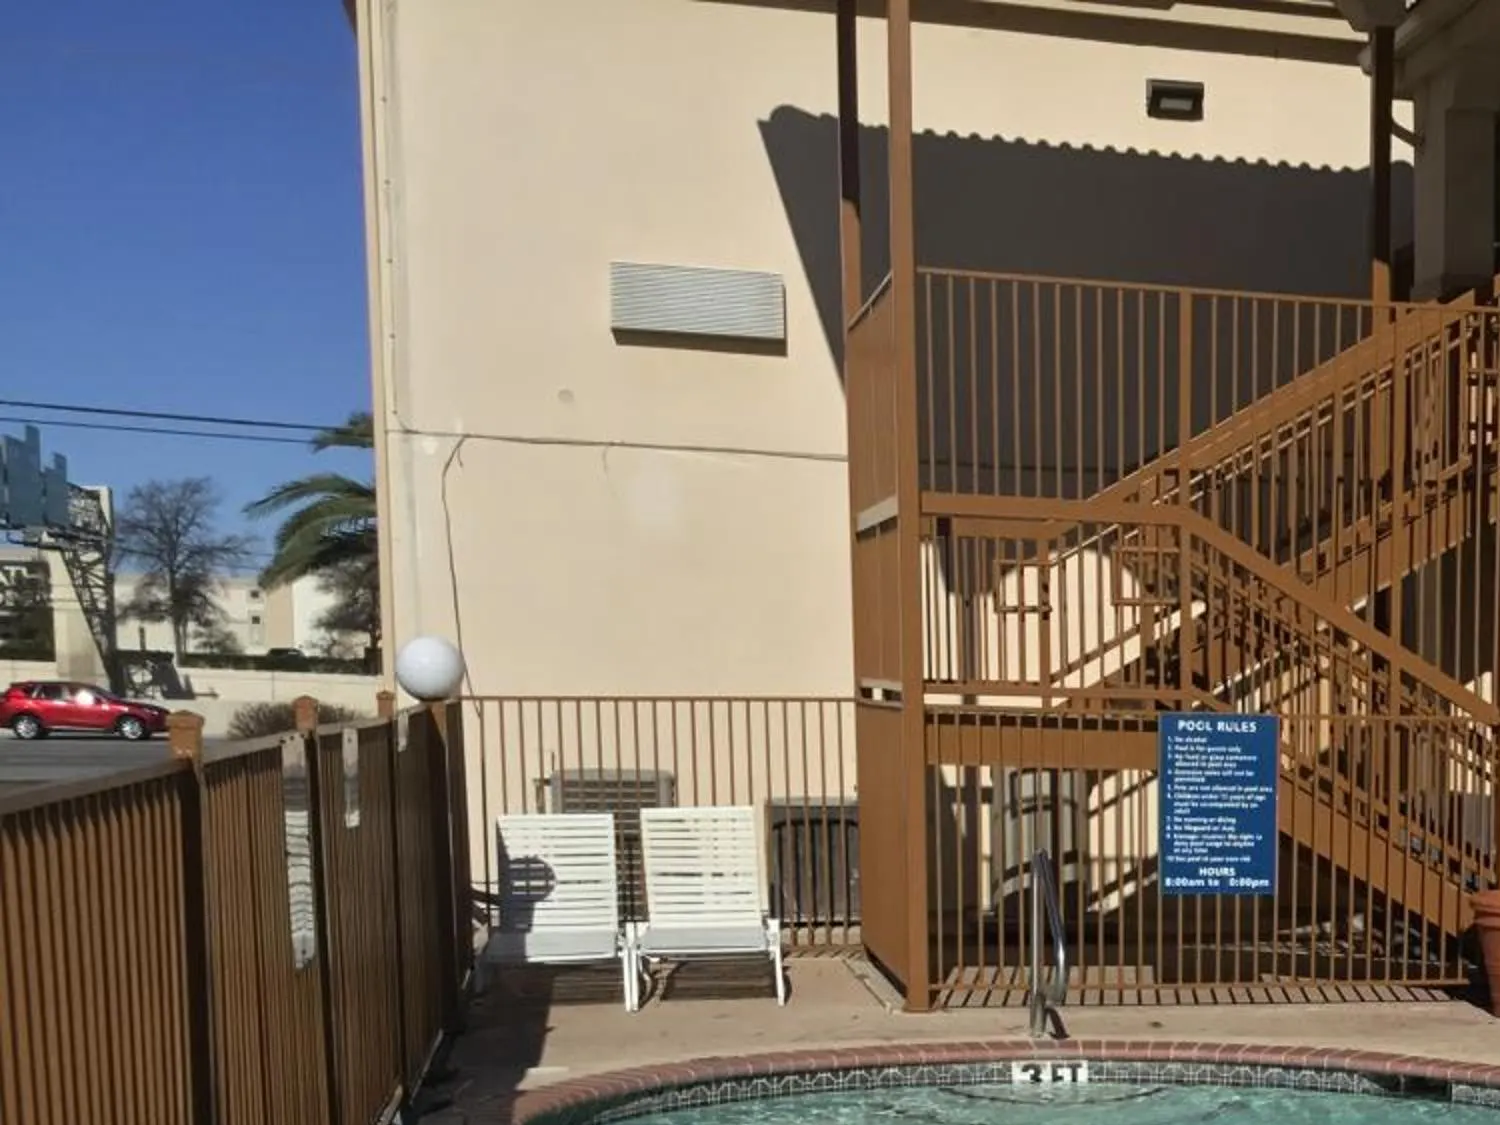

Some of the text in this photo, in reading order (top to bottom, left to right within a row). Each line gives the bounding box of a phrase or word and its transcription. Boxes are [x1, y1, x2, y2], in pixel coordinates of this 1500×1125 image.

[1178, 720, 1257, 733] POOL RULES
[1199, 867, 1236, 876] HOURS
[1021, 1062, 1043, 1082] 3
